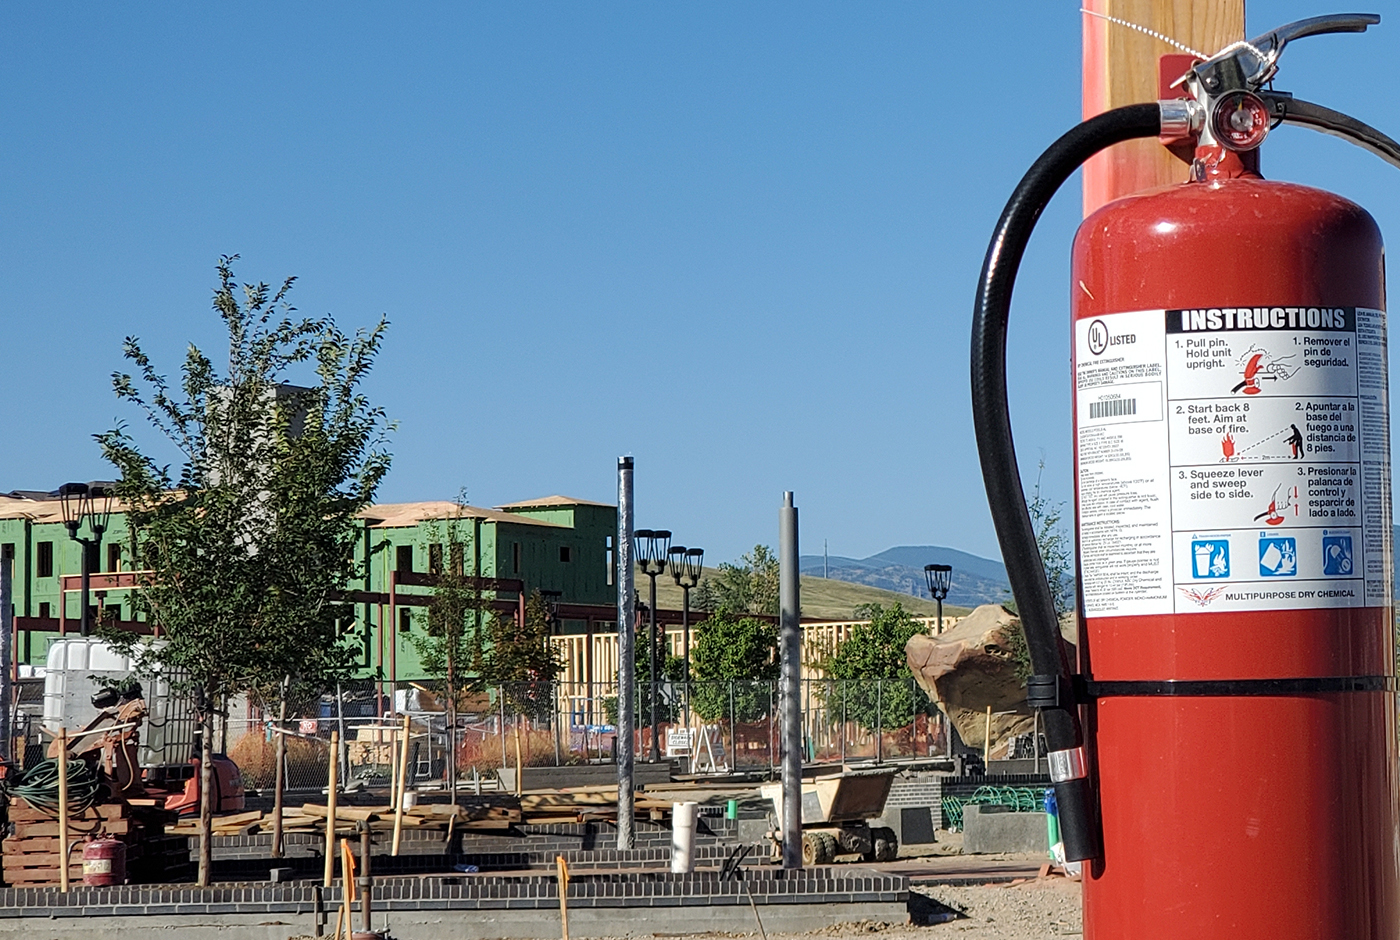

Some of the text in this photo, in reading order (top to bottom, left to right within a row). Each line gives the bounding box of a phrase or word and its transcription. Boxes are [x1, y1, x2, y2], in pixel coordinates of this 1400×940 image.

[1182, 308, 1346, 331] INSTRUCTIONS
[1092, 328, 1103, 347] UL
[1110, 334, 1136, 346] LISTED
[1304, 337, 1342, 346] Remover
[1187, 339, 1206, 347] Pull
[1209, 338, 1228, 348] pin.
[1212, 348, 1231, 356] unit
[1304, 348, 1331, 358] pin de
[1187, 359, 1225, 369] upright.
[1304, 358, 1349, 368] seguridad.
[1188, 404, 1212, 413] Start
[1216, 404, 1240, 412] back
[1306, 402, 1342, 412] Apuntar
[1348, 402, 1354, 411] la
[1188, 415, 1210, 423] feet.
[1213, 414, 1233, 423] Aim
[1188, 424, 1249, 434] base of fire.
[1306, 423, 1331, 432] fuego
[1347, 433, 1356, 442] de
[1315, 444, 1335, 453] pies.
[1190, 470, 1235, 479] Squeeze
[1238, 469, 1263, 478] lever
[1308, 467, 1349, 475] Presionar
[1350, 467, 1356, 475] la
[1190, 480, 1247, 489] and sweep
[1308, 478, 1342, 487] palanca
[1191, 491, 1212, 499] side
[1229, 490, 1253, 498] side.
[1309, 488, 1339, 496] control
[1309, 498, 1354, 508] esparcir de
[1309, 508, 1328, 517] lado
[1337, 508, 1356, 517] lado.
[1226, 592, 1296, 601] MULTIPURPOSE
